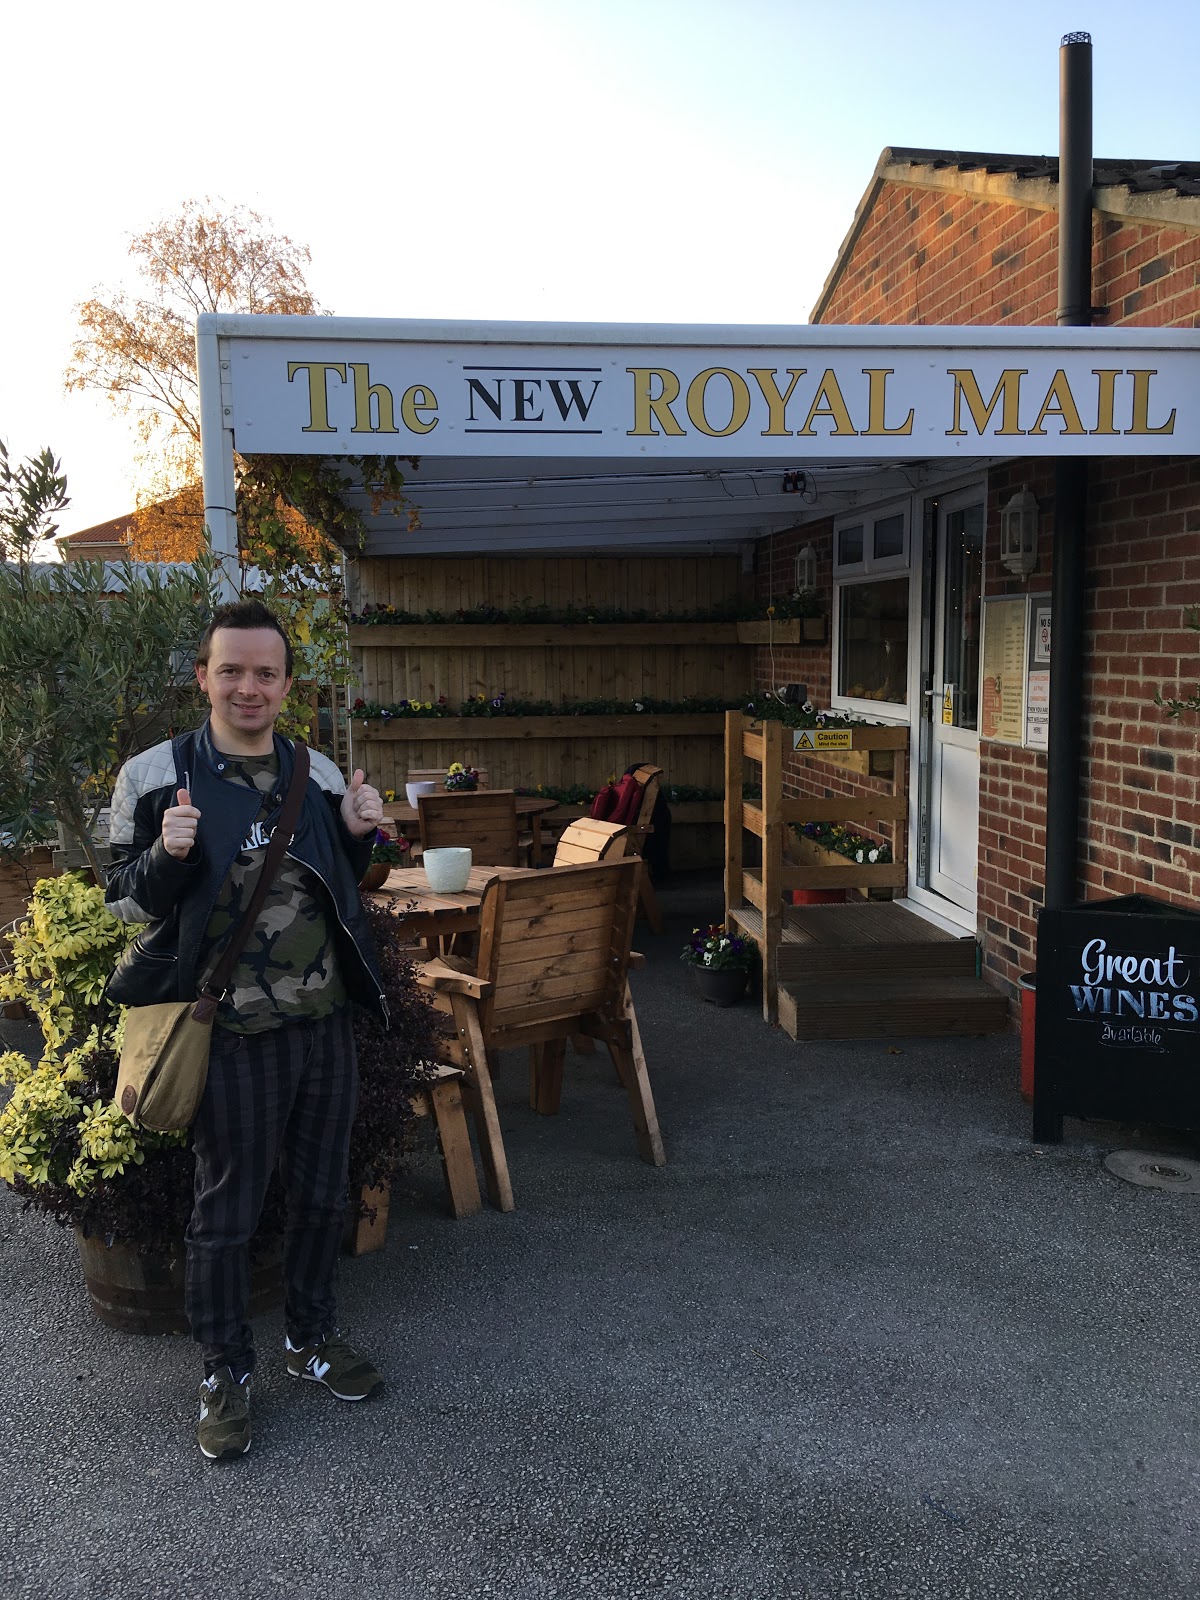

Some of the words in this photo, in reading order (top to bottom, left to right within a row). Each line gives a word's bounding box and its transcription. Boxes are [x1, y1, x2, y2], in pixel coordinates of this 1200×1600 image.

[286, 361, 440, 435] The
[464, 378, 602, 422] NEW
[625, 366, 915, 438] ROYAL
[945, 368, 1177, 437] MAIL
[1040, 618, 1046, 628] NO
[817, 733, 849, 741] Caution
[1081, 938, 1191, 989] Great
[1069, 985, 1199, 1022] WINES
[1102, 1025, 1161, 1045] available
